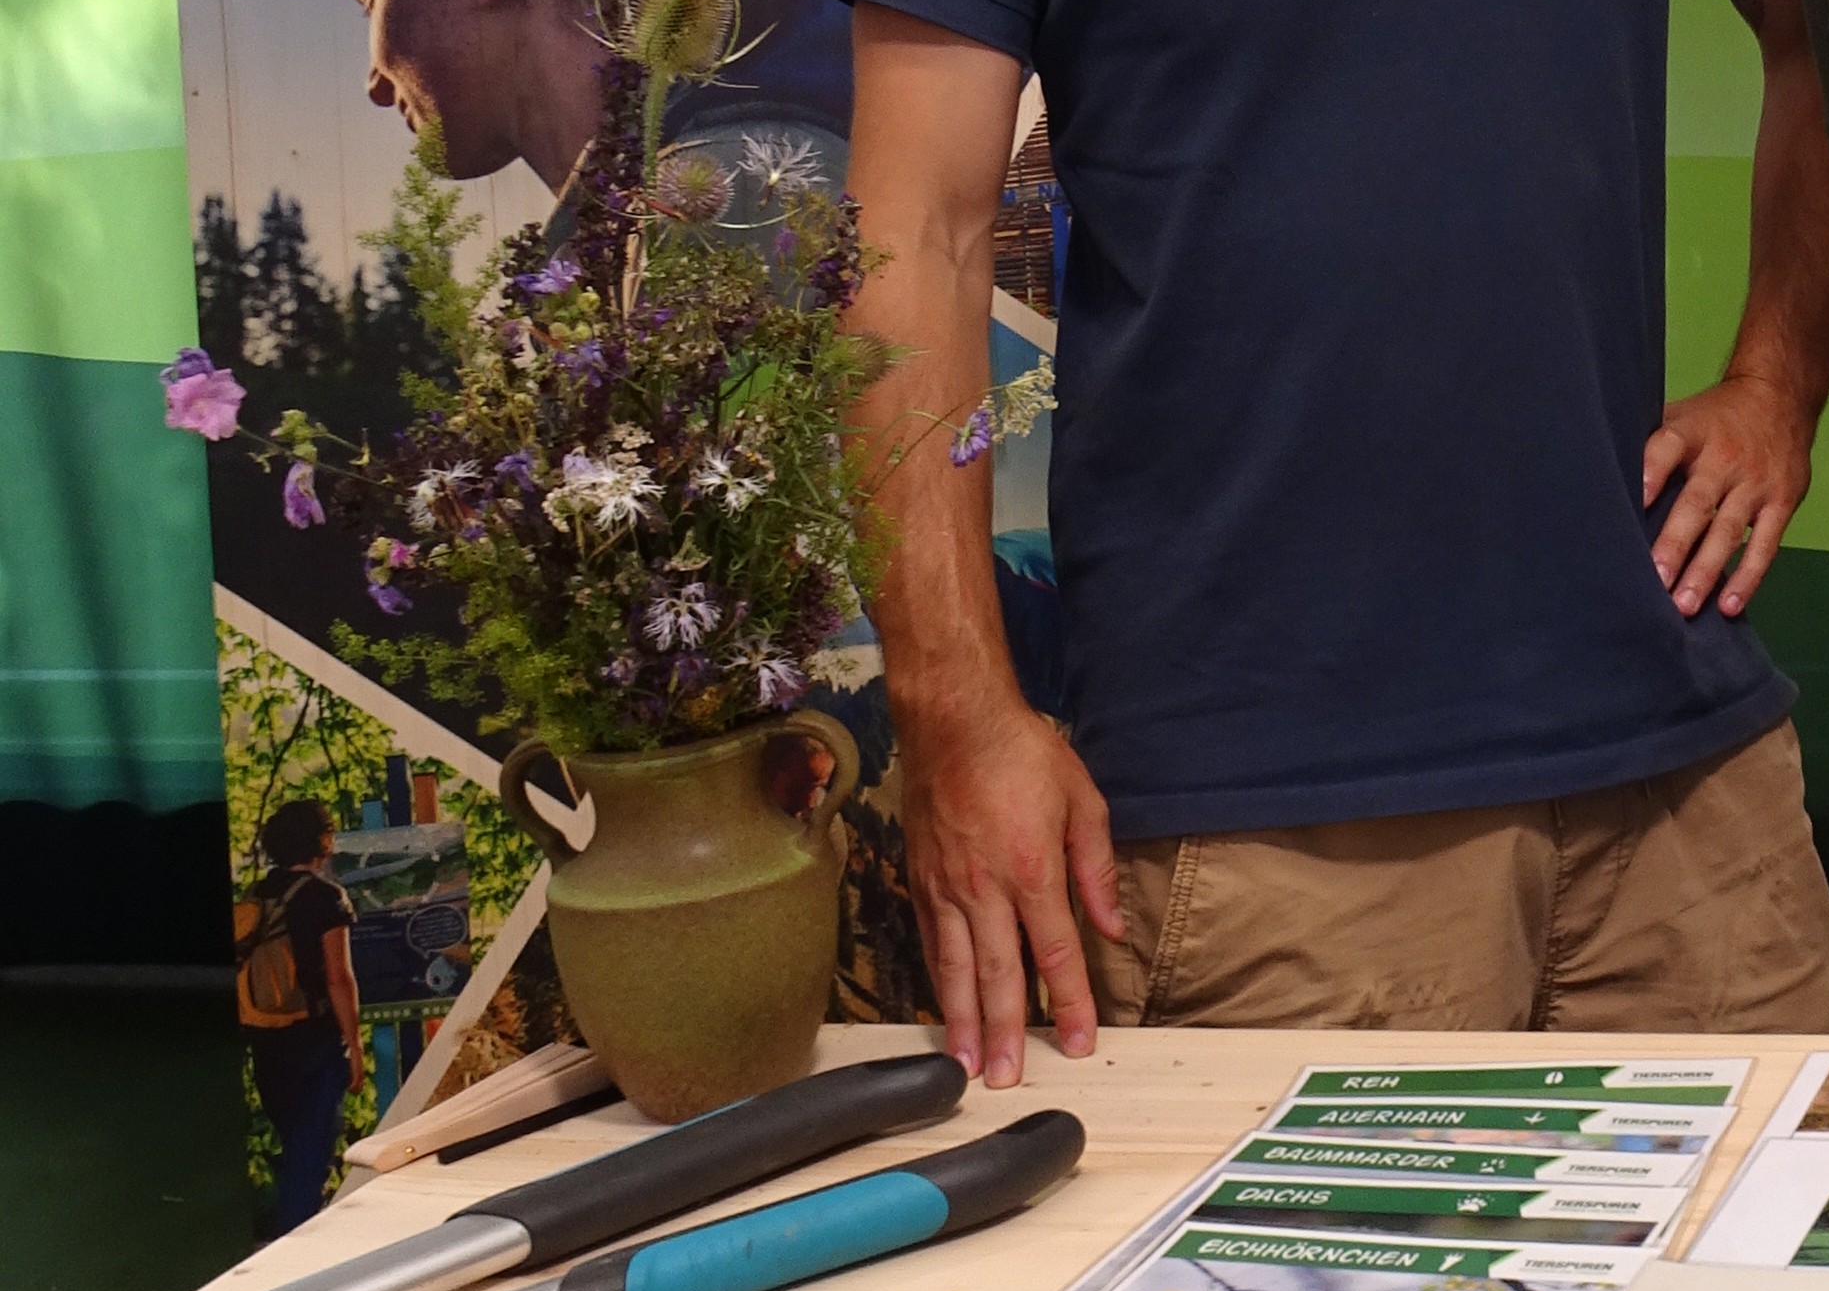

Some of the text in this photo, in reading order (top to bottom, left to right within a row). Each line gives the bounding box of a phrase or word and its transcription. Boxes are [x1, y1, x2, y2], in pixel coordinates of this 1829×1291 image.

[1632, 1071, 1714, 1079] TIERSPUREN
[1342, 1075, 1400, 1090] REH
[1317, 1109, 1466, 1125] AUERHAHN
[1611, 1117, 1694, 1127] TIERSPUREN
[1262, 1146, 1455, 1169] BAUMMARDER
[1567, 1164, 1653, 1175] TIERSPUREN
[1234, 1186, 1332, 1205] DACHS
[1553, 1199, 1642, 1210] TIERSPUREN
[1198, 1236, 1420, 1268] EICHHÖRNCHEN
[1524, 1259, 1616, 1271] TIERSPUREN
